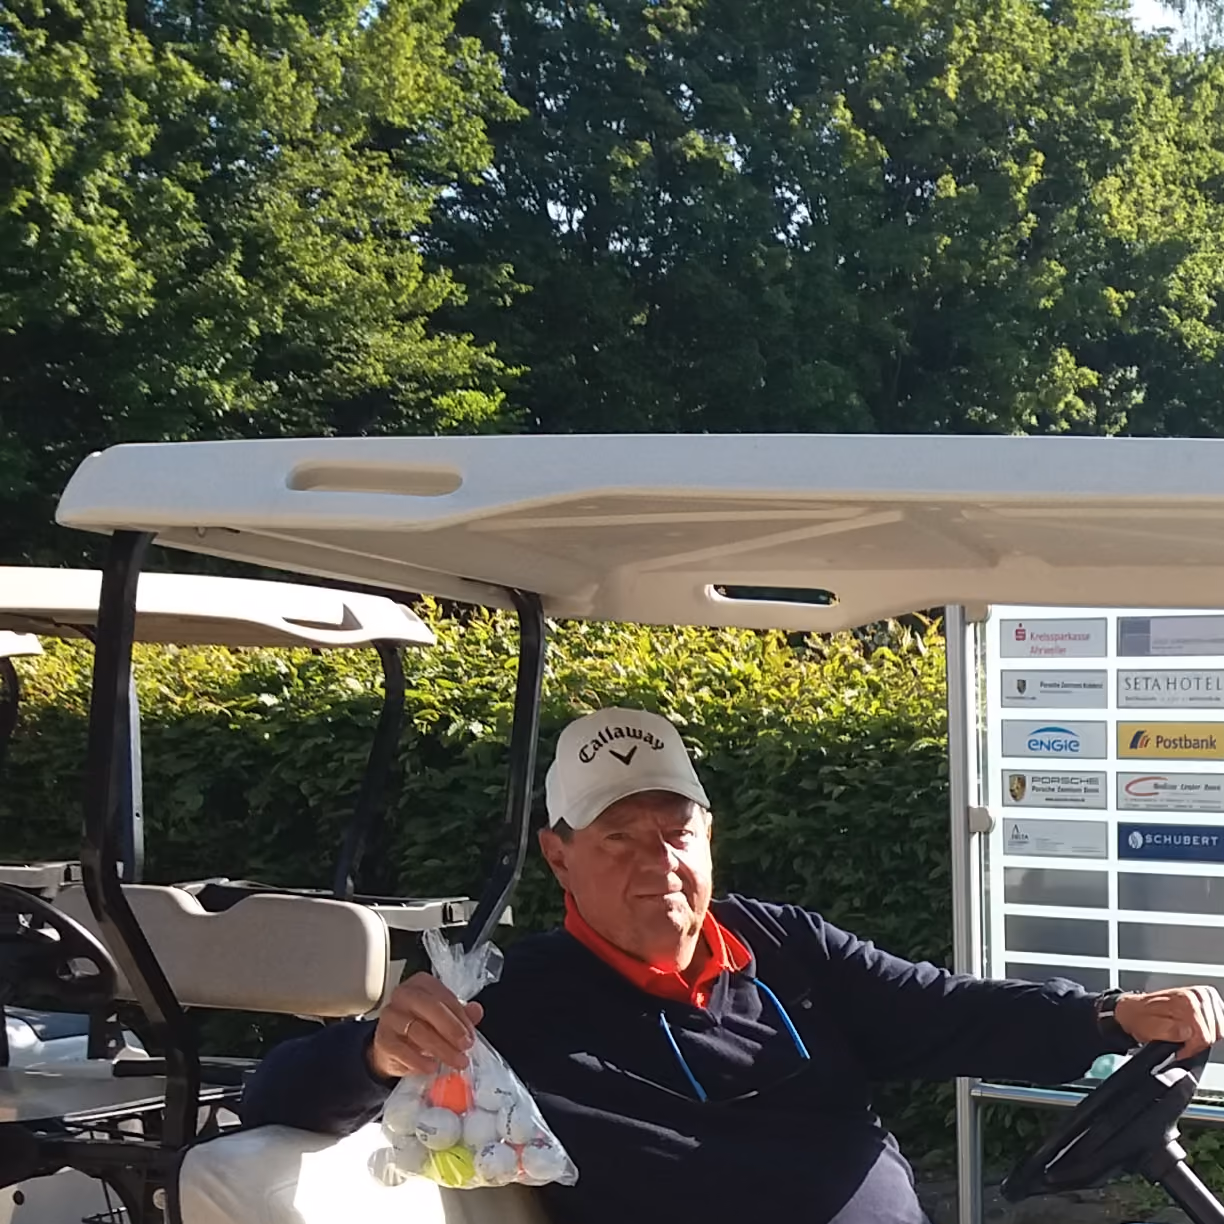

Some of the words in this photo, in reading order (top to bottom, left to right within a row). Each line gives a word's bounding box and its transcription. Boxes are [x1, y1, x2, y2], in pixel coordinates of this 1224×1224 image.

[1030, 632, 1090, 642] Kreissparkasse
[1125, 677, 1160, 691] SETA
[1166, 677, 1223, 691] HOTEL
[578, 726, 665, 763] Callaway
[1156, 734, 1217, 751] Postbank
[1032, 777, 1099, 785] PORSCHE
[1145, 834, 1219, 847] SCHUBERT
